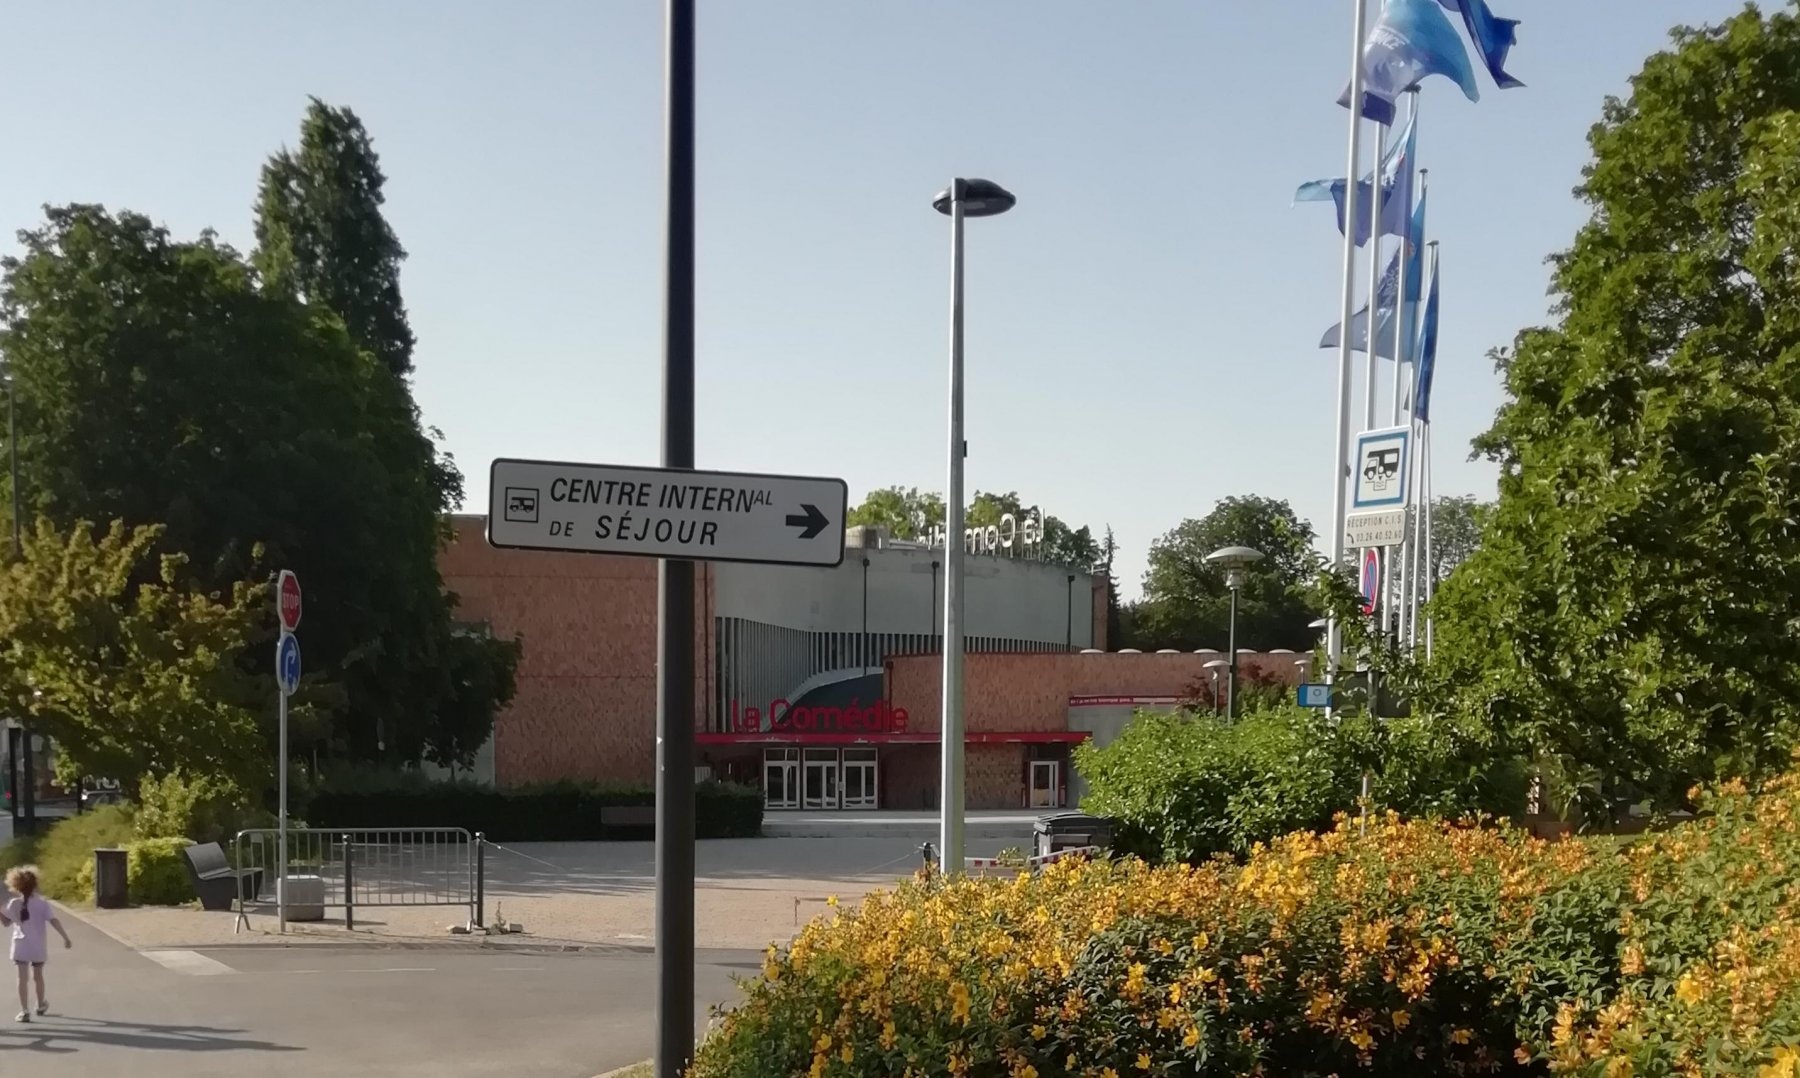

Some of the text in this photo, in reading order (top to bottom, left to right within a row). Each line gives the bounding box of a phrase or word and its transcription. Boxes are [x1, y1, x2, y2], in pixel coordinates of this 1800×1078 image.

[550, 477, 652, 507] CENTRE
[549, 510, 719, 546] DE SÉJOUR
[282, 592, 299, 610] STOP
[769, 697, 909, 732] Comédie
